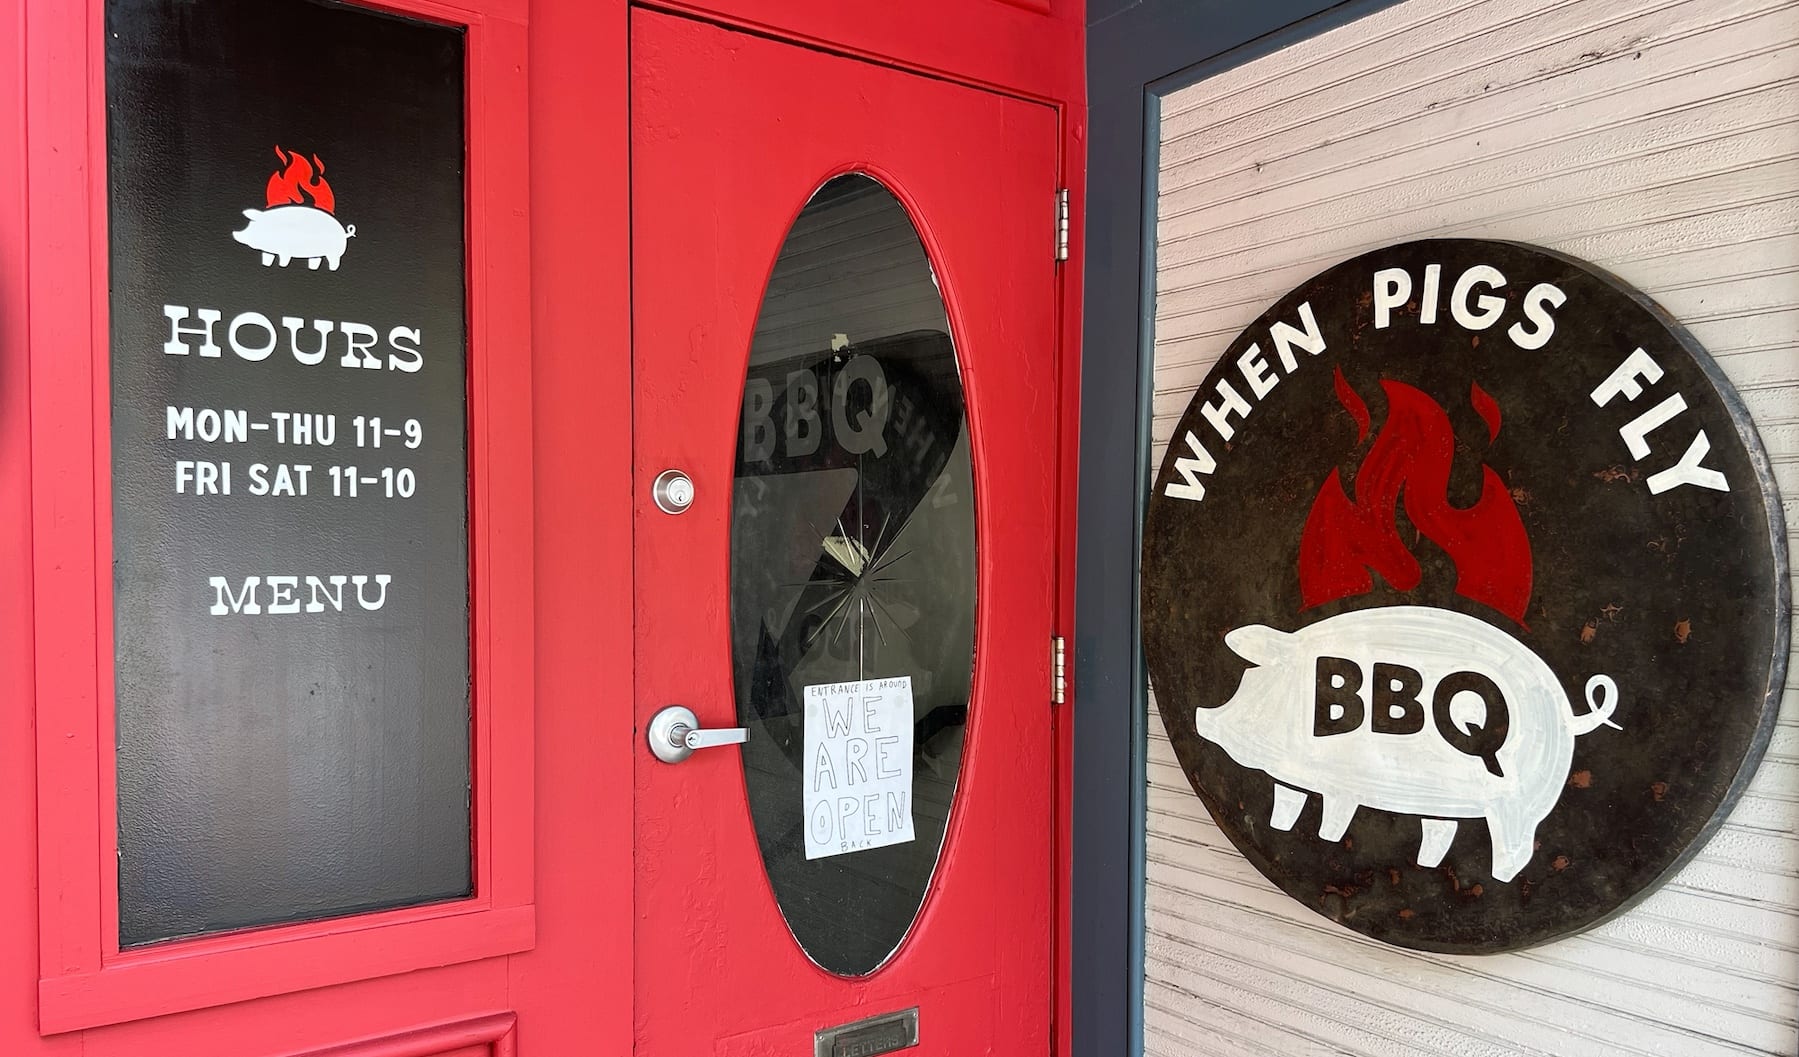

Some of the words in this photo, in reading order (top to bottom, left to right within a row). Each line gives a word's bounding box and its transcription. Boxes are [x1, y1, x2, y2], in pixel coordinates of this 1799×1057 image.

[163, 304, 424, 373] HOURS
[743, 354, 889, 459] BBQ
[1164, 301, 1328, 502] WHEN
[1373, 264, 1567, 350] PIGS
[1590, 346, 1731, 495] FLY
[166, 405, 336, 447] MON-THU
[352, 415, 423, 449] 11-9
[175, 460, 231, 496] FRI
[248, 463, 313, 497] SAT
[328, 465, 416, 498] 11-10
[209, 574, 392, 616] MENU
[811, 684, 859, 697] ENTRANCE
[866, 683, 874, 692] IS
[822, 696, 883, 738] WE
[1313, 656, 1510, 778] BBQ
[813, 736, 902, 792] ARE
[811, 791, 906, 845] OPEN
[840, 840, 872, 852] BACK
